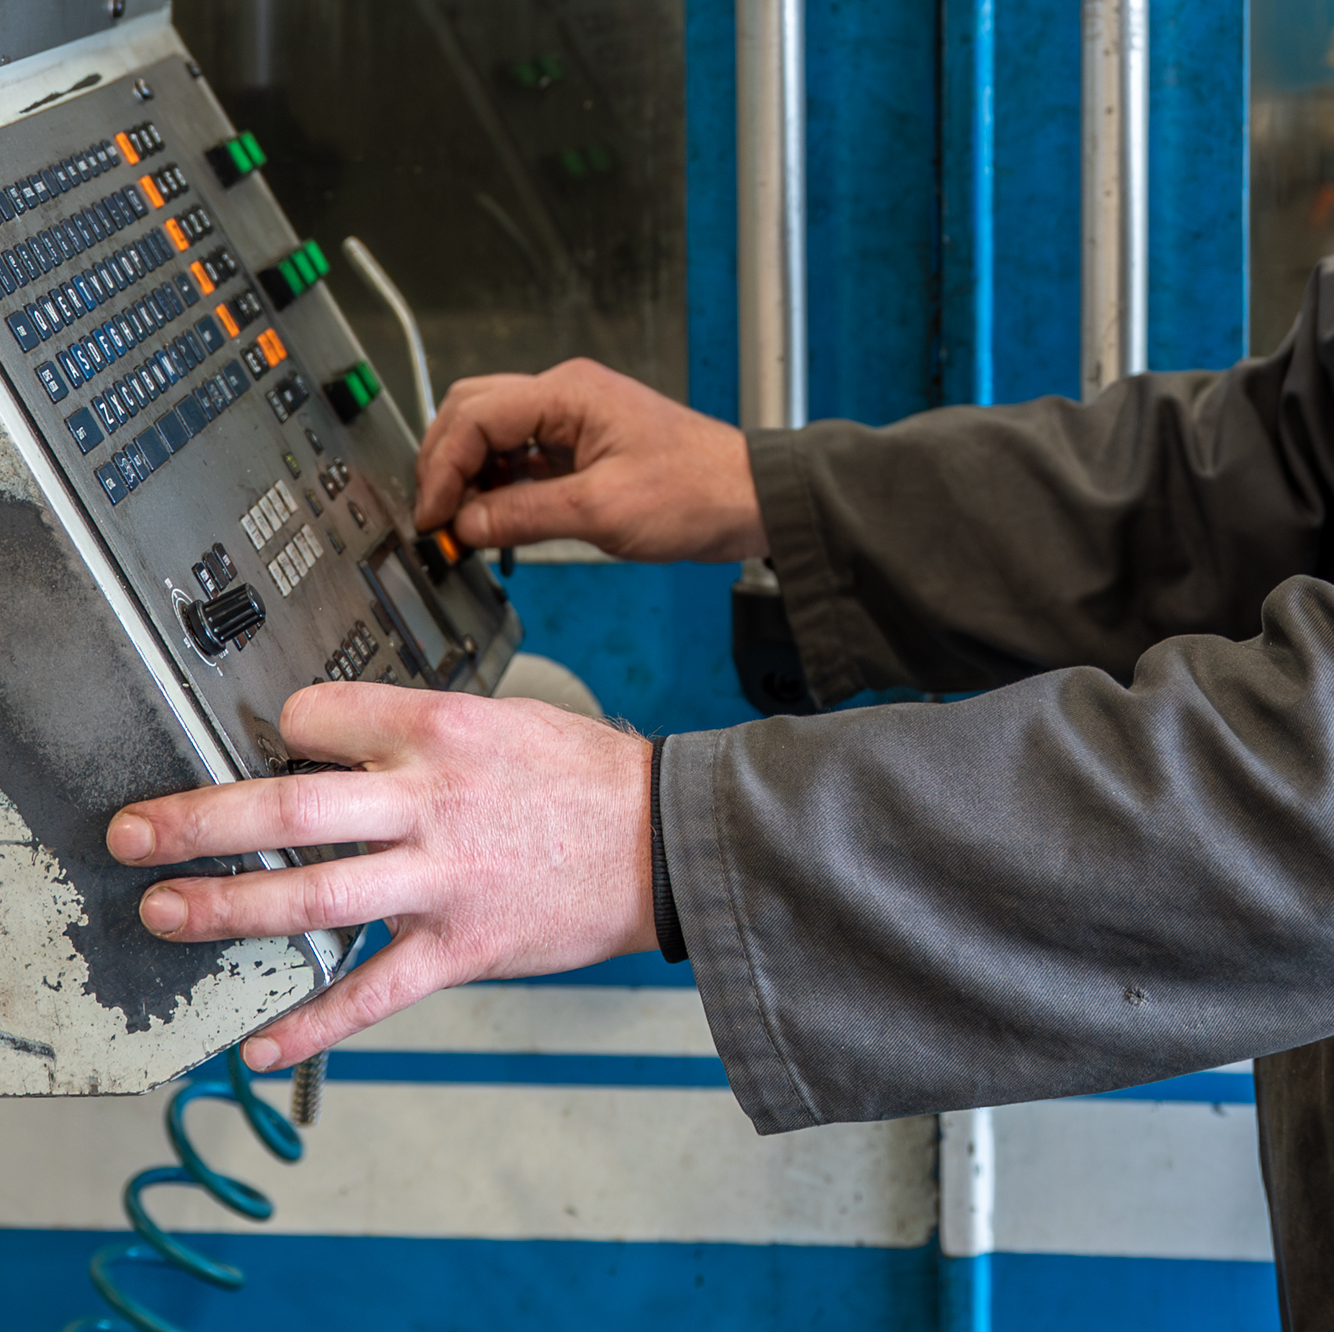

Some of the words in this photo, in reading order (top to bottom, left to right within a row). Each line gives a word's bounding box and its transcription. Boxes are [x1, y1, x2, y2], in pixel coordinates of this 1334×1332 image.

[130, 133, 143, 151] 7
[34, 310, 47, 330] Q
[45, 302, 59, 323] W
[58, 296, 71, 317] E
[68, 289, 81, 308] R
[80, 282, 91, 301] T
[90, 276, 102, 295] Y
[101, 269, 113, 288] U
[130, 250, 141, 269] P
[66, 358, 79, 378] A
[78, 351, 89, 370] S
[88, 343, 100, 362] D
[99, 336, 110, 356] F
[110, 328, 122, 347] G
[120, 322, 133, 341] H
[132, 315, 142, 334] J
[140, 307, 153, 326] K
[150, 301, 162, 319] L
[100, 403, 114, 424] Z
[111, 395, 125, 416] X
[122, 387, 134, 406] C
[132, 379, 144, 398] V
[142, 371, 155, 391] B
[152, 365, 166, 384] N
[161, 356, 175, 375] M
